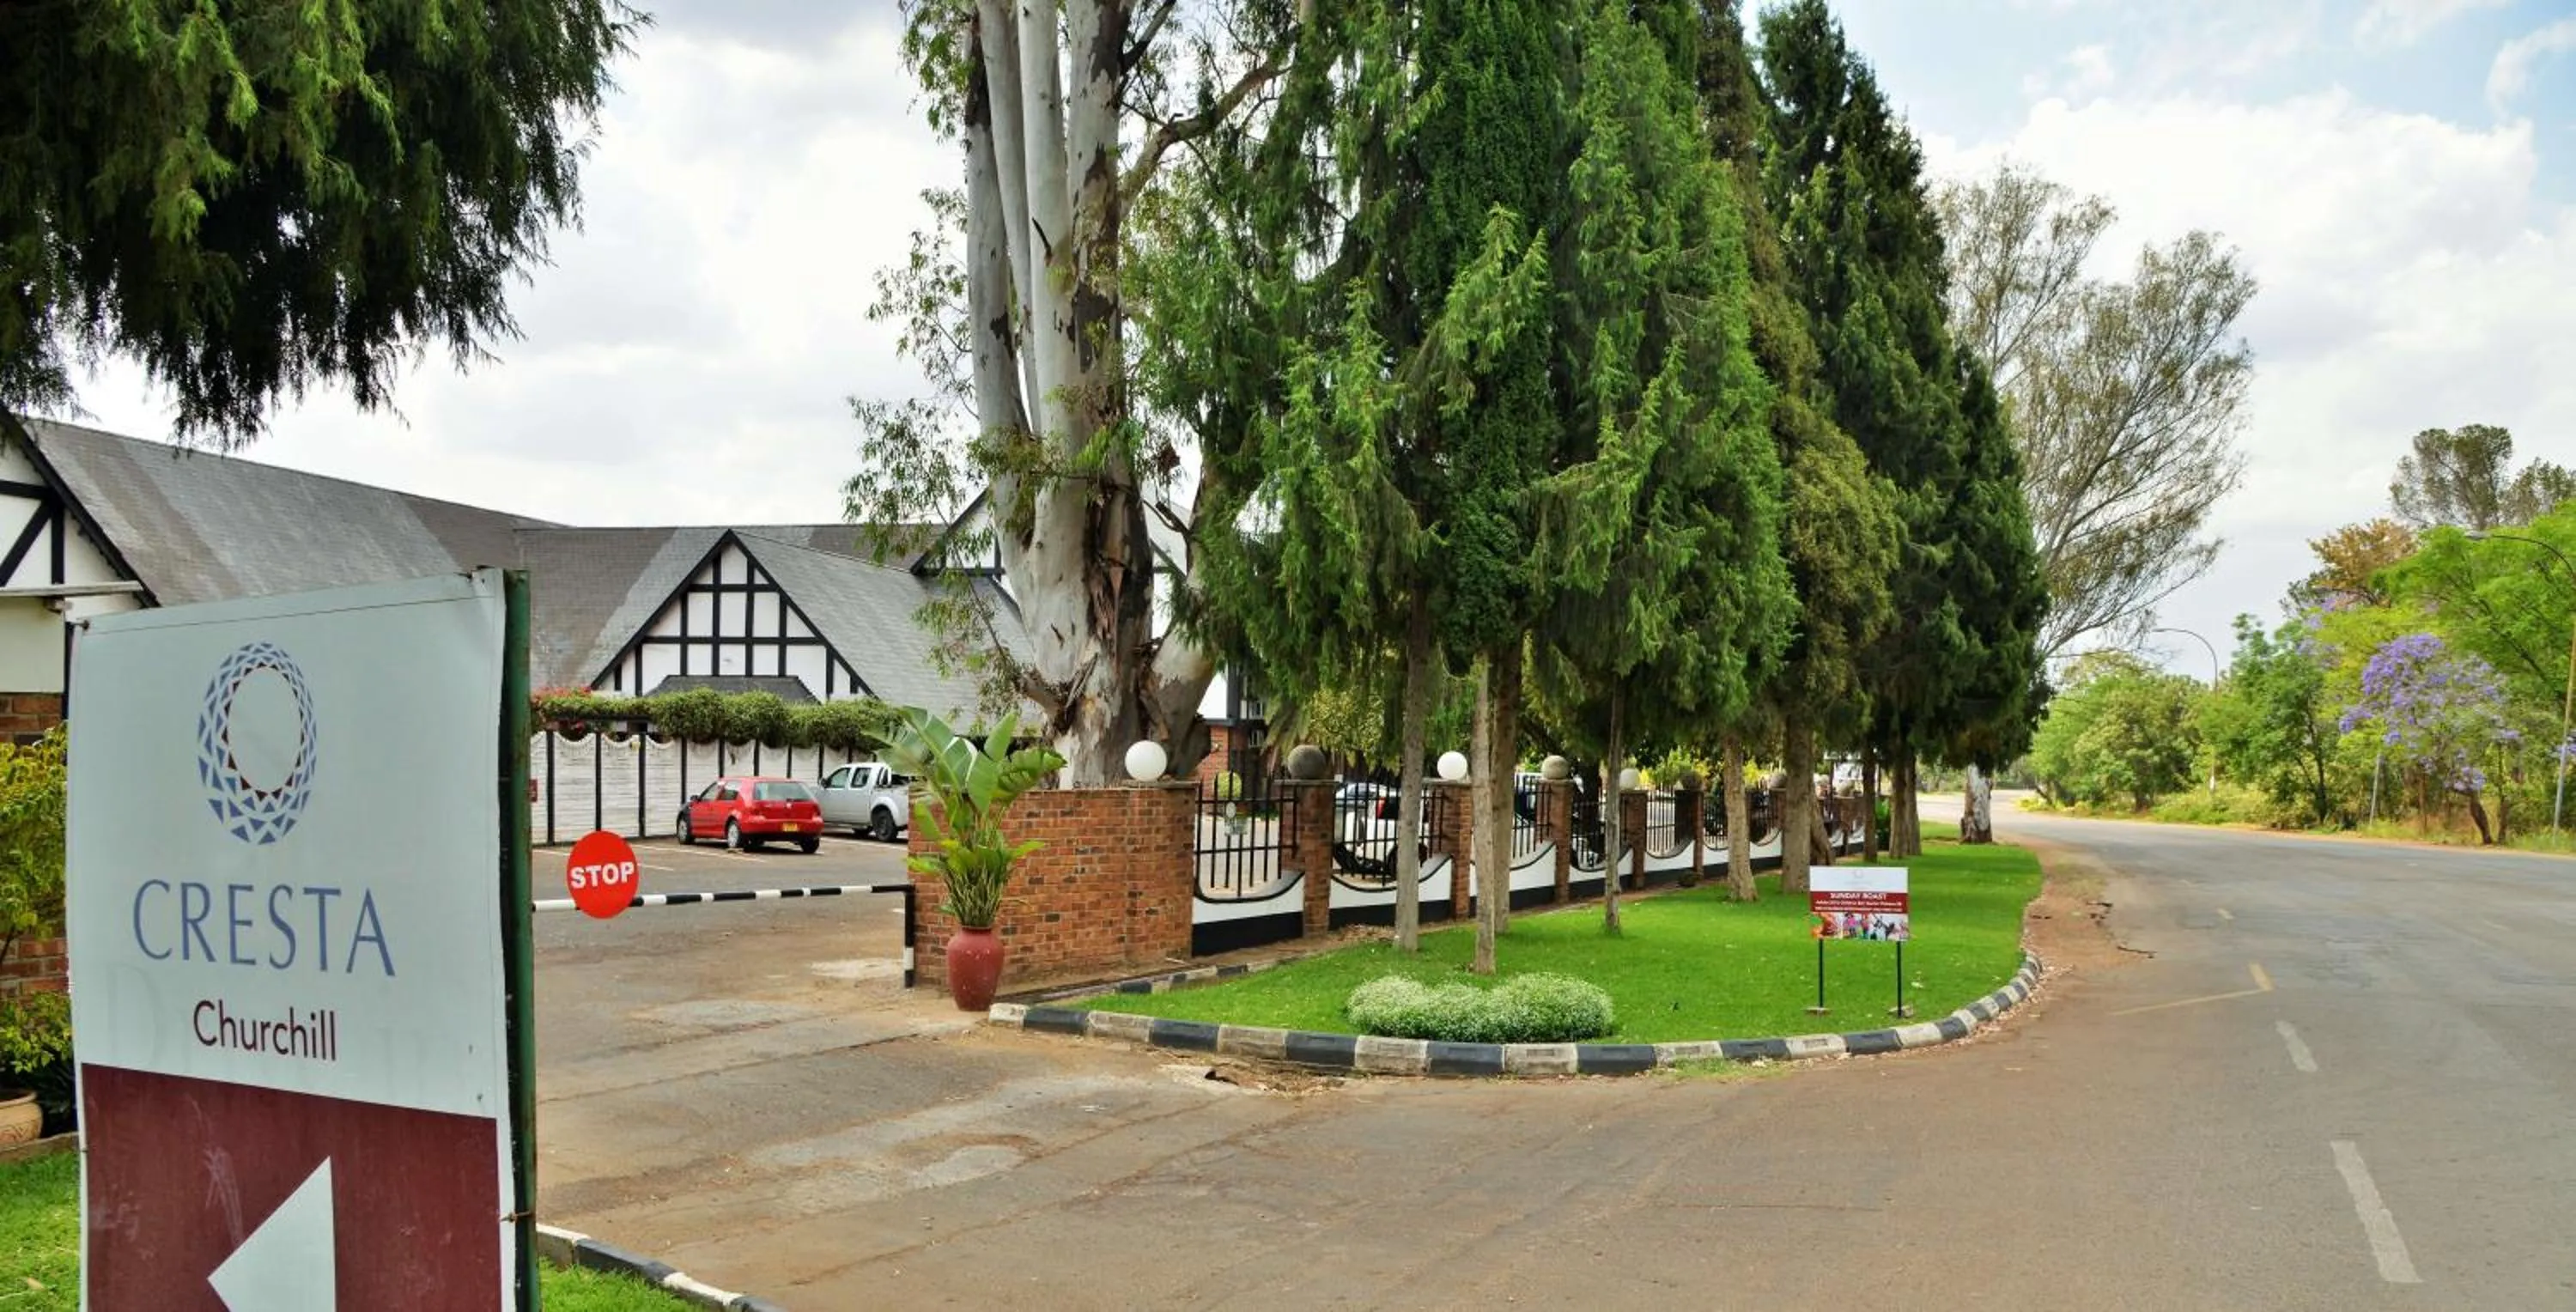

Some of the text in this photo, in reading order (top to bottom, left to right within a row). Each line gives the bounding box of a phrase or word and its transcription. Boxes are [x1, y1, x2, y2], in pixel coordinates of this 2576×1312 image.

[570, 861, 635, 889] STOP
[133, 879, 396, 977] CRESTA
[193, 999, 337, 1061] Churchill
